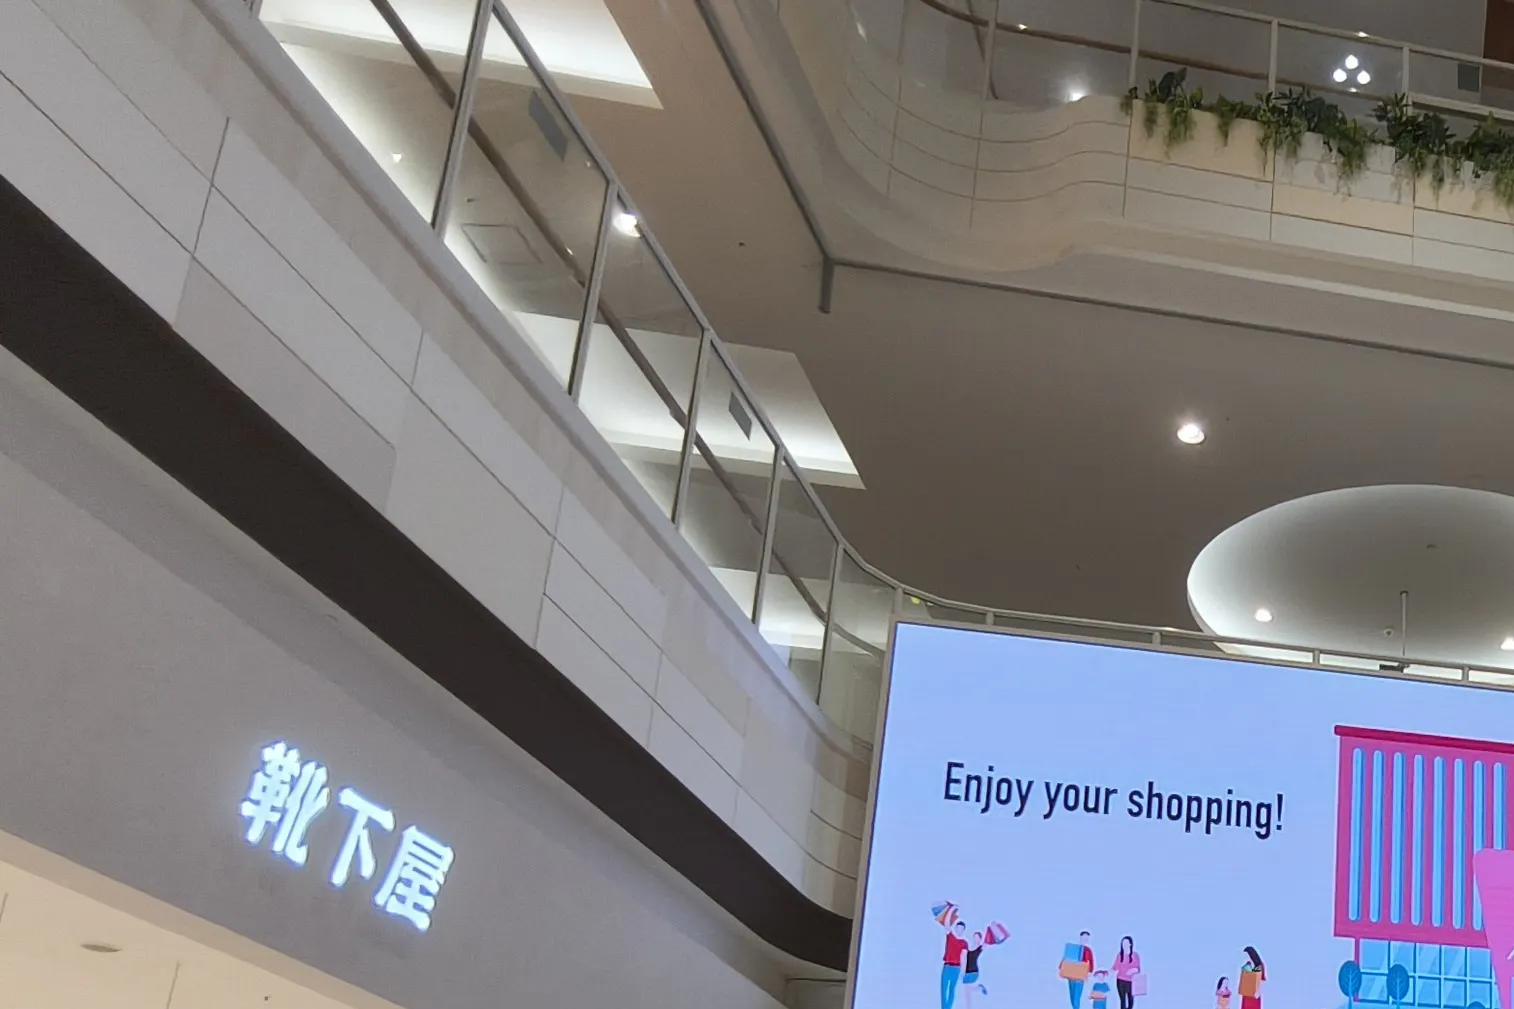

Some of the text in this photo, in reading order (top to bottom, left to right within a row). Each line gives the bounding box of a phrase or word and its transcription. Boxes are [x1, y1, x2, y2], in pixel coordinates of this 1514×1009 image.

[240, 741, 455, 932] 靴下屋
[943, 760, 1284, 840] Enjoy your shopping!
